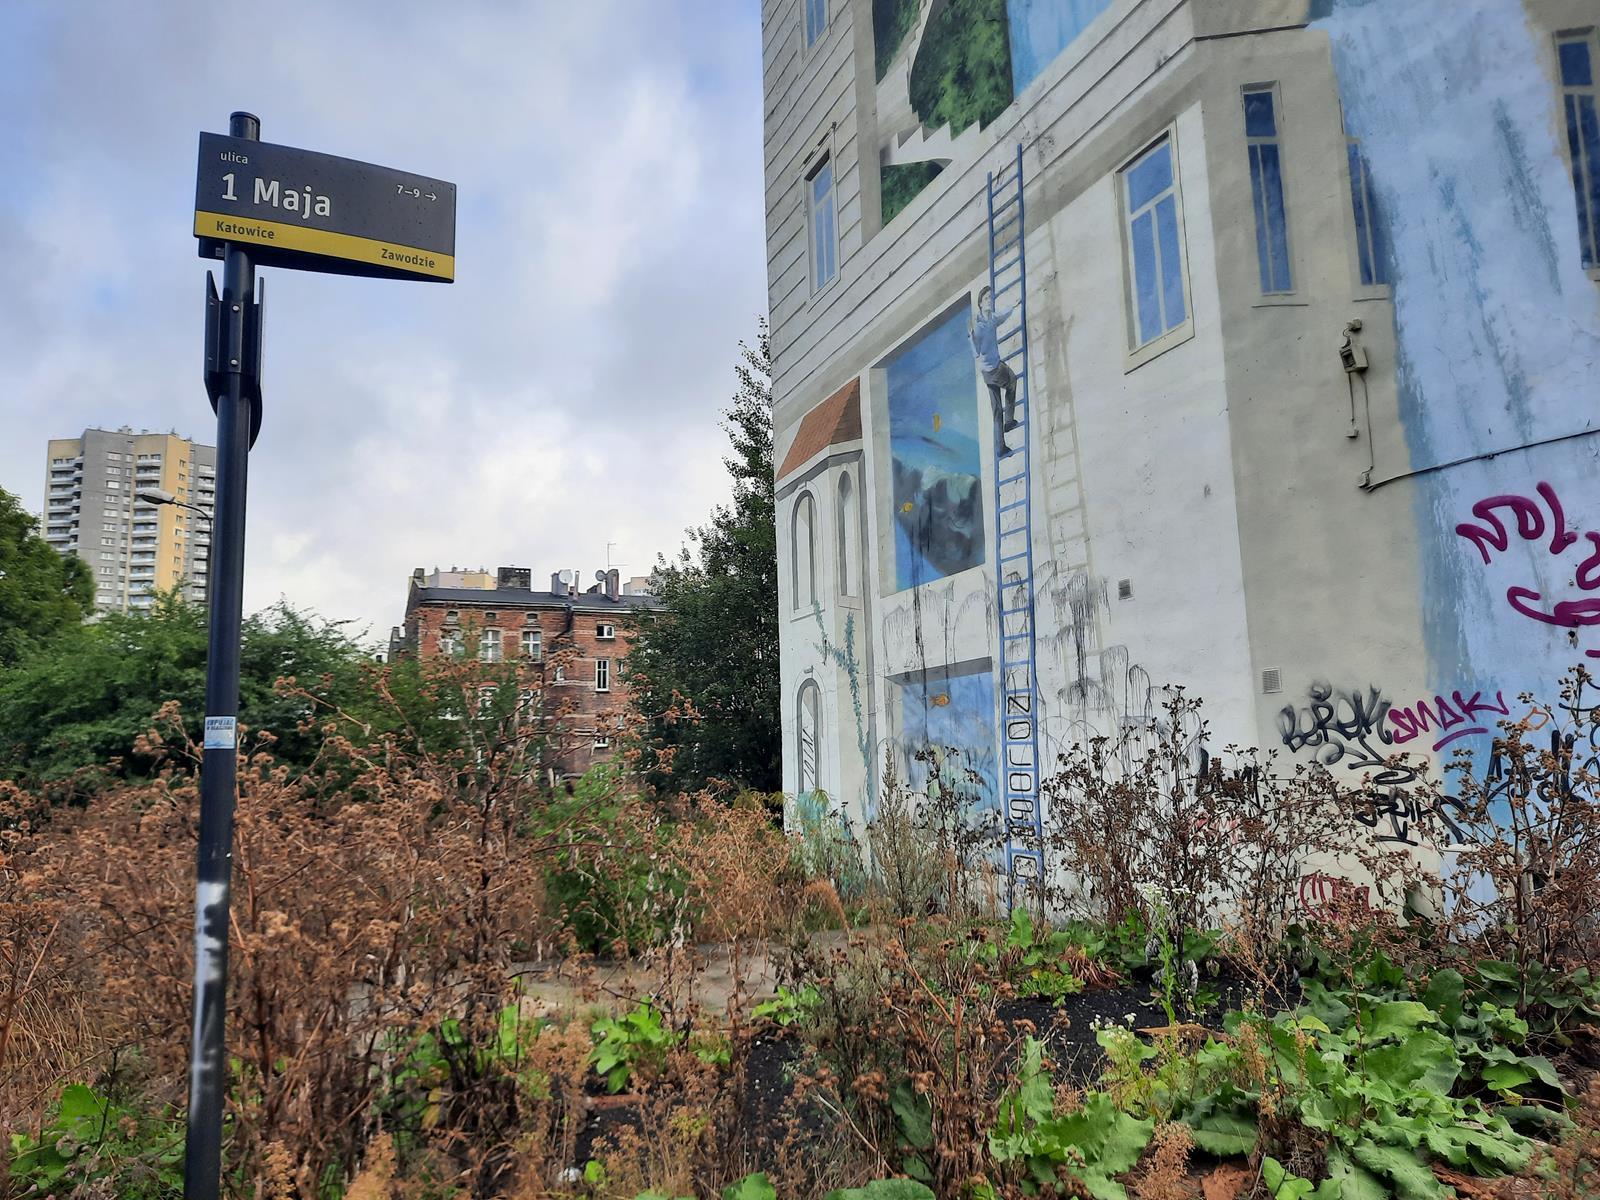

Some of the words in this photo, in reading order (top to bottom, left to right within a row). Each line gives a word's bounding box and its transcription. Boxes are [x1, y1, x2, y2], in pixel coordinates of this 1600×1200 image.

[220, 151, 249, 165] ulica
[221, 172, 238, 201] 1
[253, 177, 331, 220] Maja
[216, 220, 275, 240] Katowice
[381, 247, 436, 269] Zawodzie
